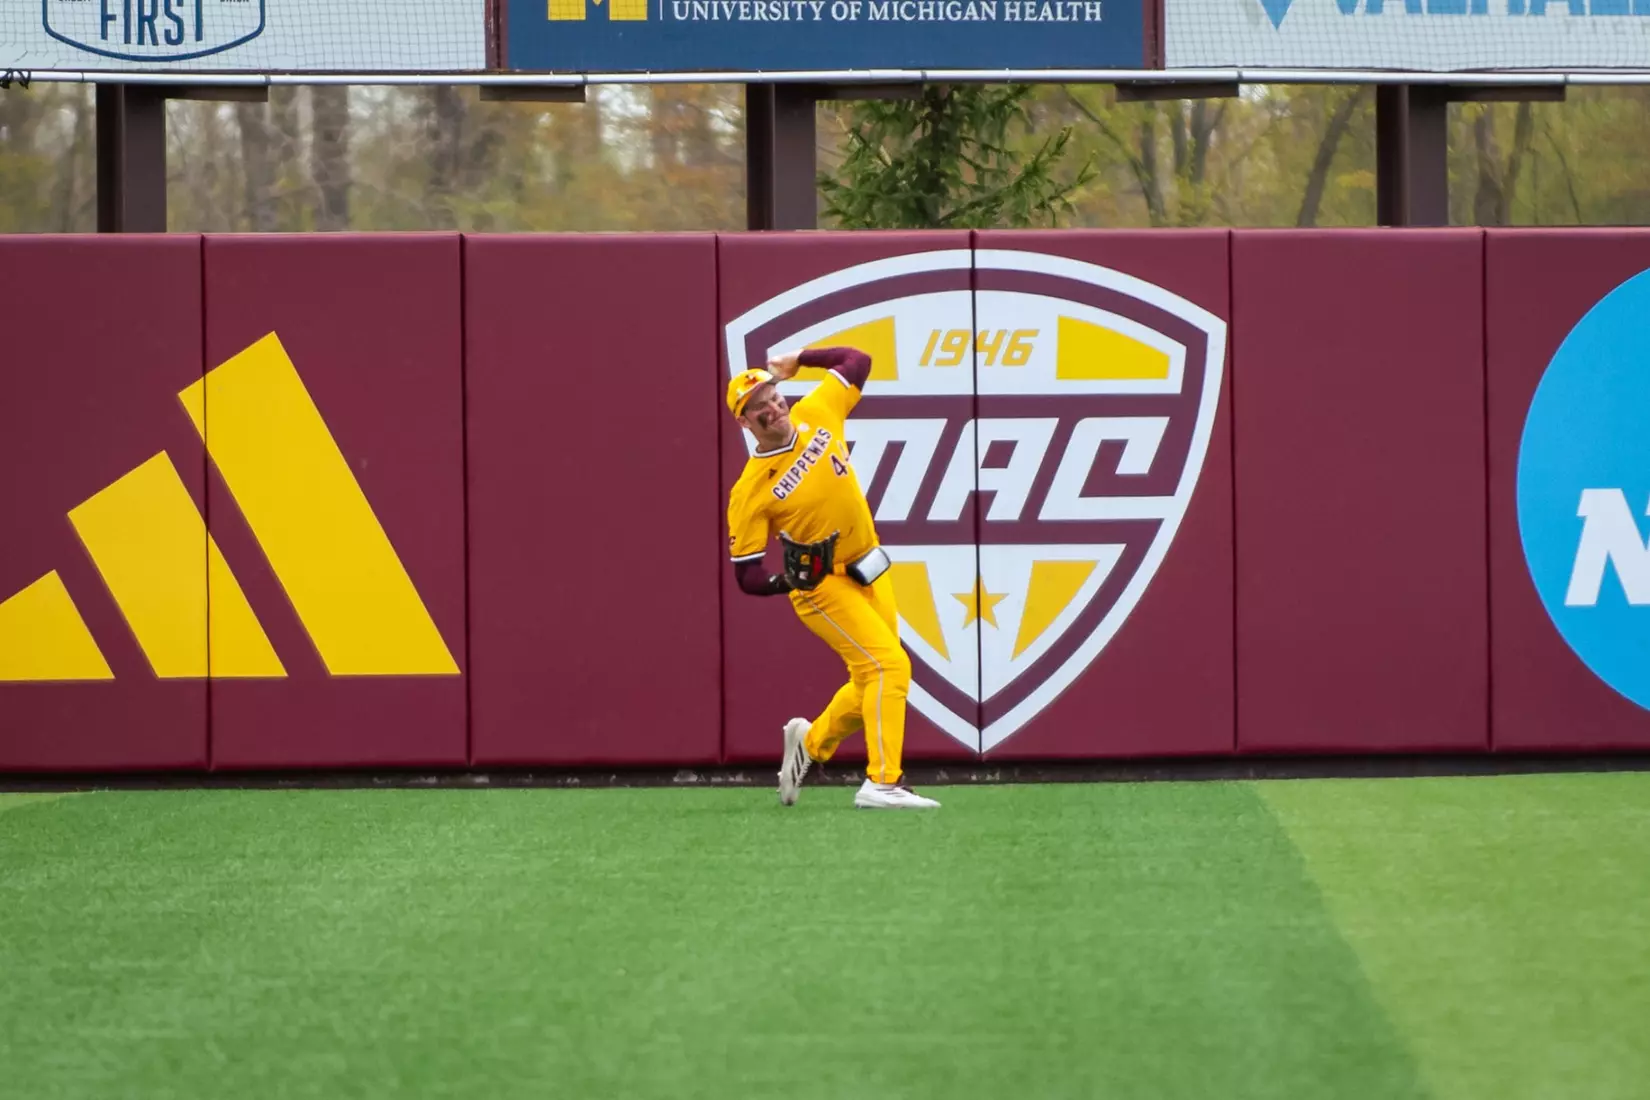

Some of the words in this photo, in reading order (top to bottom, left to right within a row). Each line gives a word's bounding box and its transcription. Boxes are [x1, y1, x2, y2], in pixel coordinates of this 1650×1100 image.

[101, 0, 203, 46] FIRST
[672, 0, 826, 21] UNIVERSITY
[831, 0, 862, 21] OF
[868, 0, 997, 21] MICHIGAN
[1003, 0, 1102, 21] HEALTH
[919, 328, 1040, 367] 1946
[772, 428, 833, 501] CHIPPEWAS
